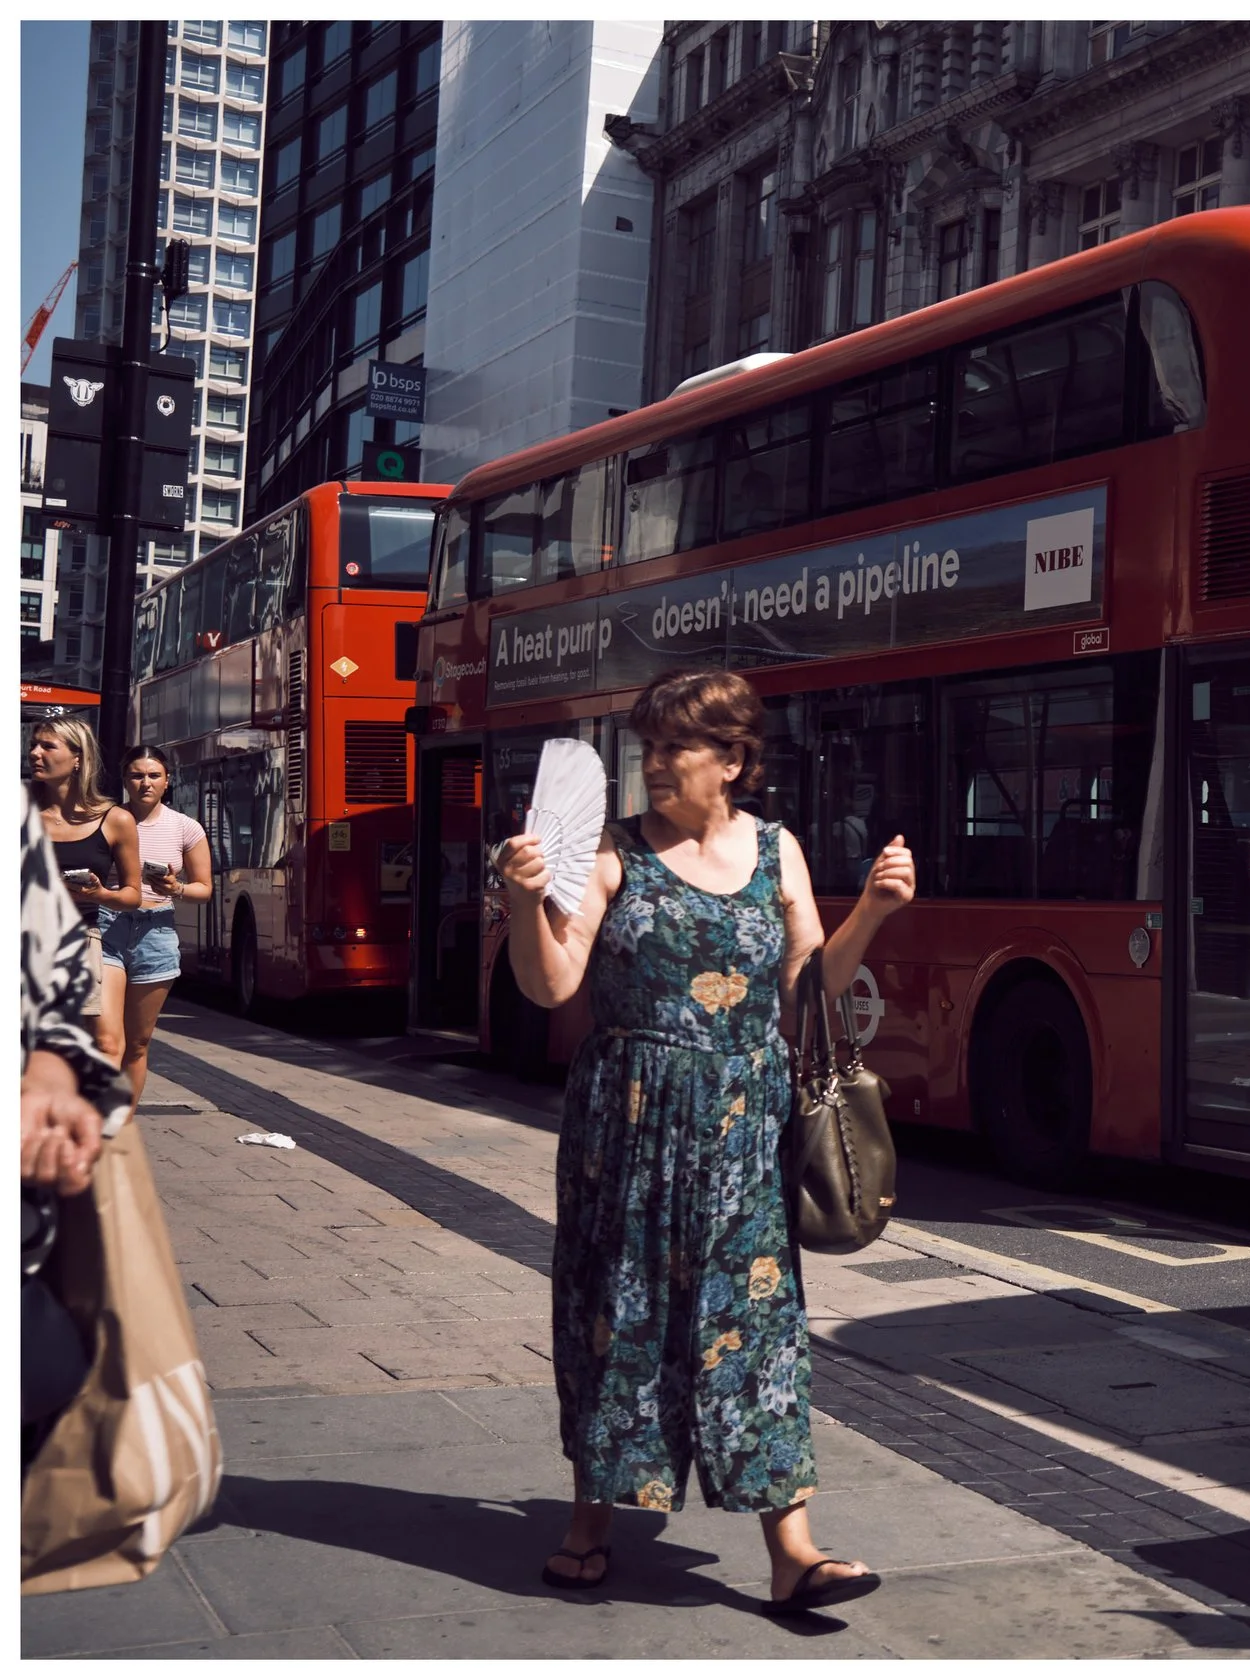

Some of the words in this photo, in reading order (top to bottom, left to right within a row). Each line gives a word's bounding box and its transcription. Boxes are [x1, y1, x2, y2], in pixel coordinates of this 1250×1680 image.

[389, 372, 421, 392] bsps
[370, 393, 384, 401] 020
[377, 451, 404, 480] Q
[1034, 545, 1084, 574] NIBE
[495, 629, 509, 667] A
[513, 624, 552, 665] heat
[556, 617, 612, 667] pump
[743, 567, 807, 623] need
[814, 575, 830, 612] a
[837, 540, 960, 619] pipeline
[1081, 633, 1102, 650] global
[33, 685, 52, 693] Road
[854, 1000, 869, 1011] USES
